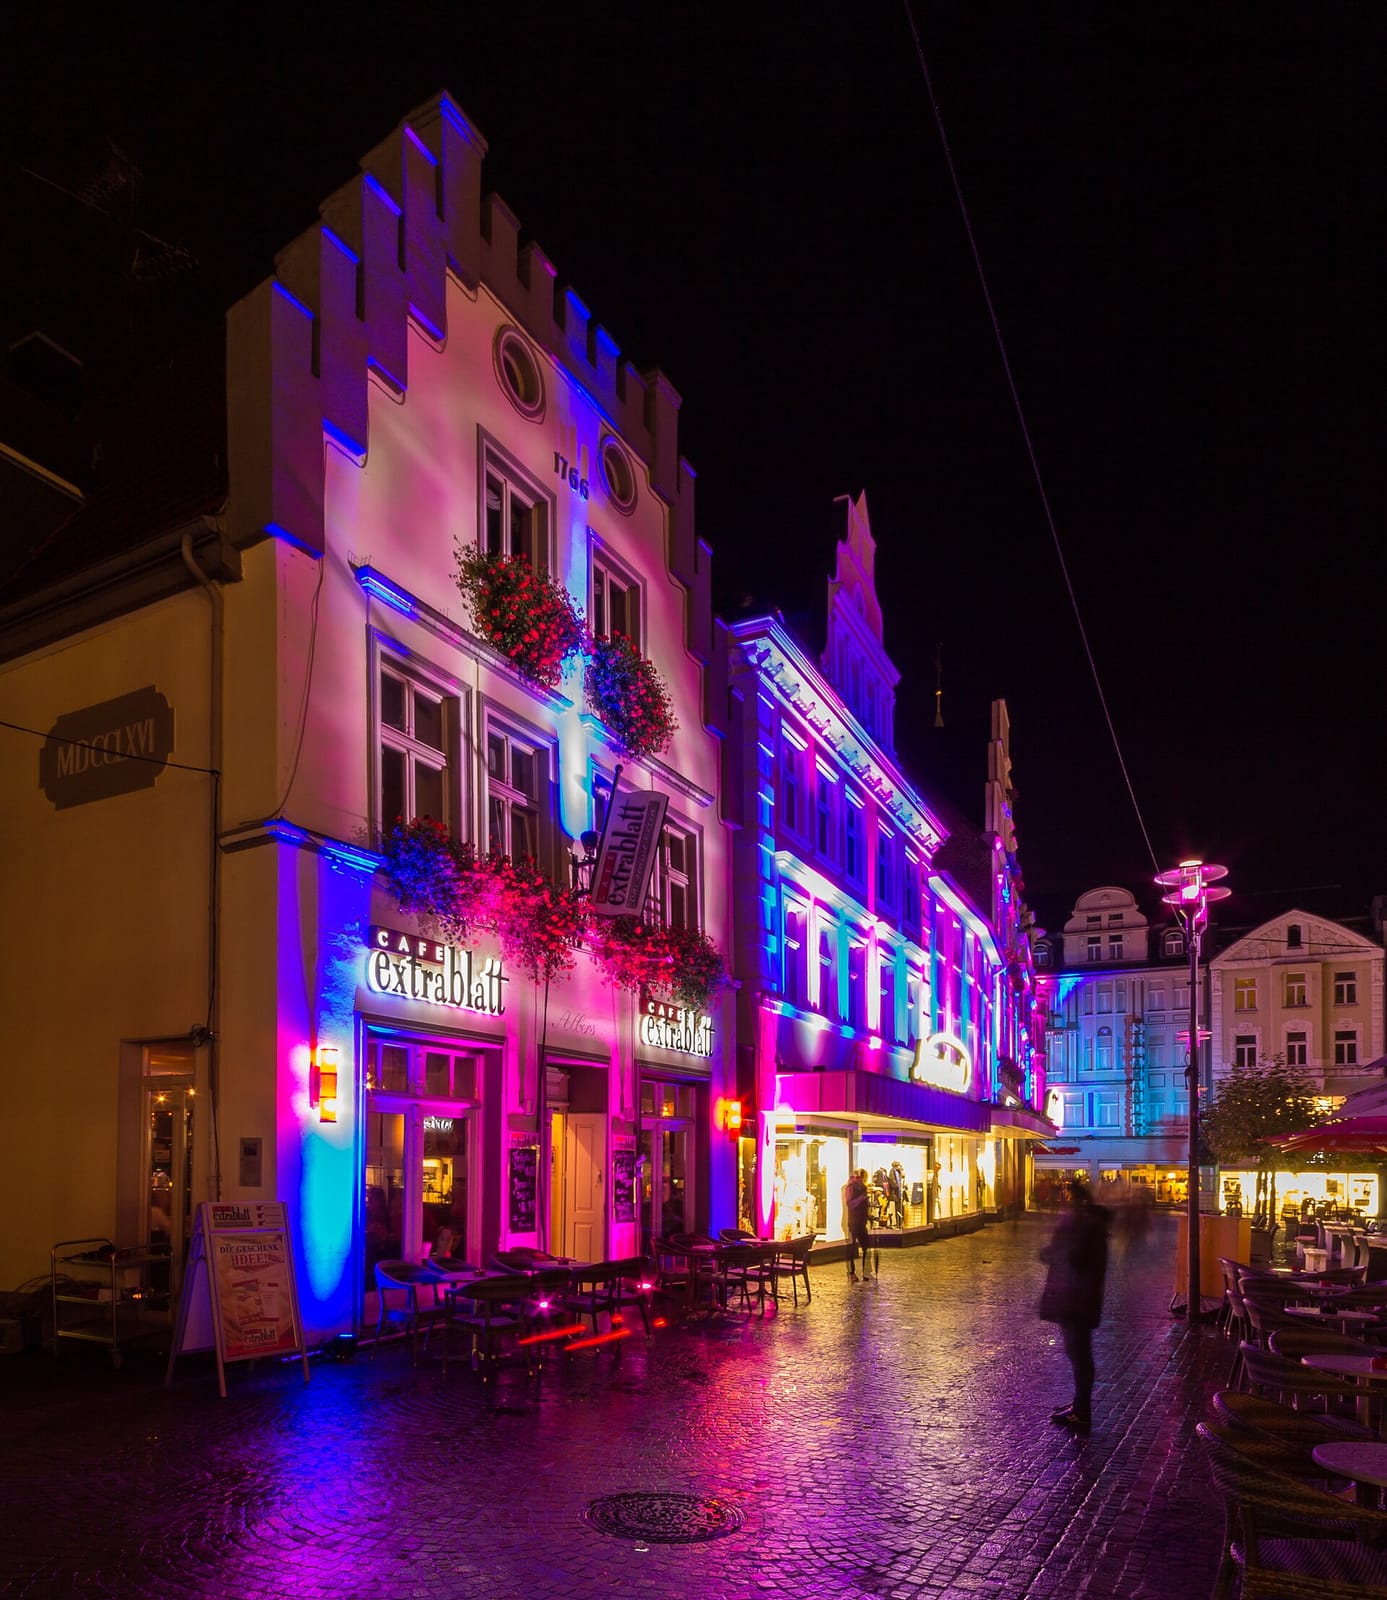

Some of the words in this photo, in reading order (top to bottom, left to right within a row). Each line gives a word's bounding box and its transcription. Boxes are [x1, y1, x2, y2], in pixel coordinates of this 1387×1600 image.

[553, 450, 590, 501] 1766
[57, 718, 156, 779] MDCCLXVI
[608, 798, 646, 906] extrablatt
[377, 931, 444, 961] CAFE
[374, 945, 510, 1015] extrablatt
[646, 1008, 716, 1057] extrablatt
[647, 1002, 683, 1021] CAFE
